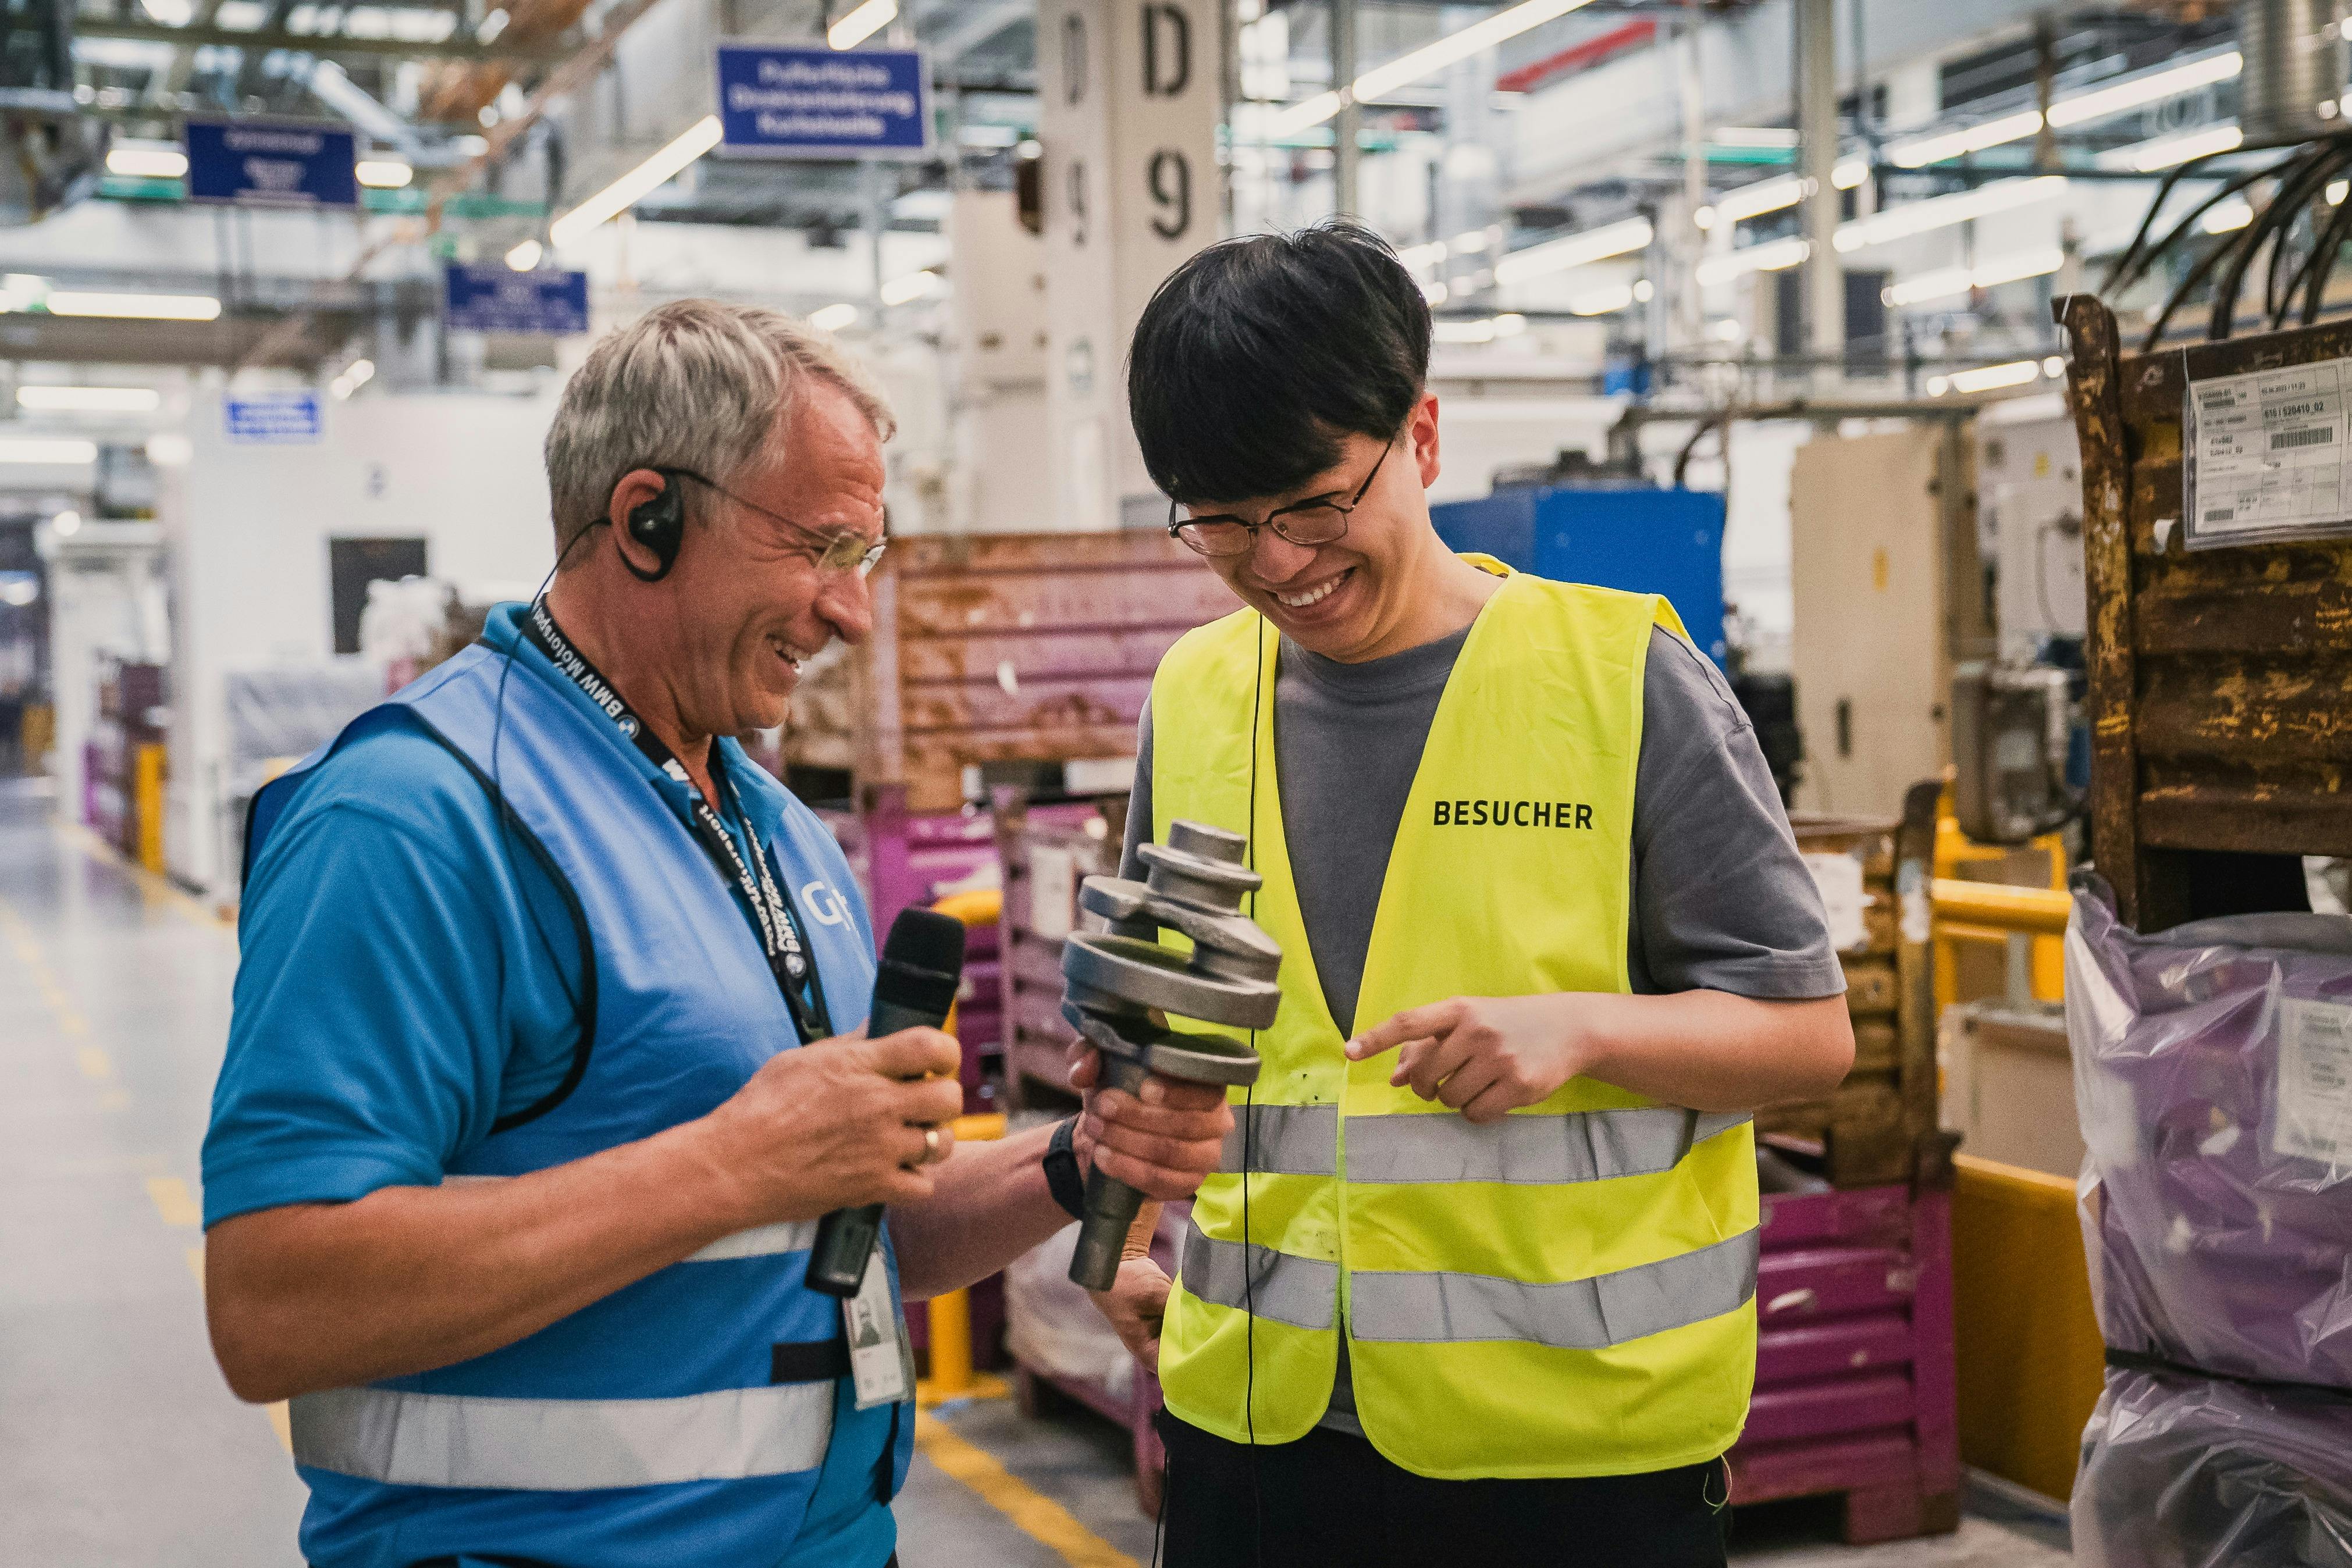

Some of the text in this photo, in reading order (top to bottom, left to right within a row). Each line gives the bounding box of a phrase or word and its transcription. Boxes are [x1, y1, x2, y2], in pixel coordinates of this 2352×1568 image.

[1141, 3, 1191, 97] D
[1147, 150, 1191, 240] 9
[579, 673, 624, 718] BMW
[1433, 800, 1593, 830] BESUCHER
